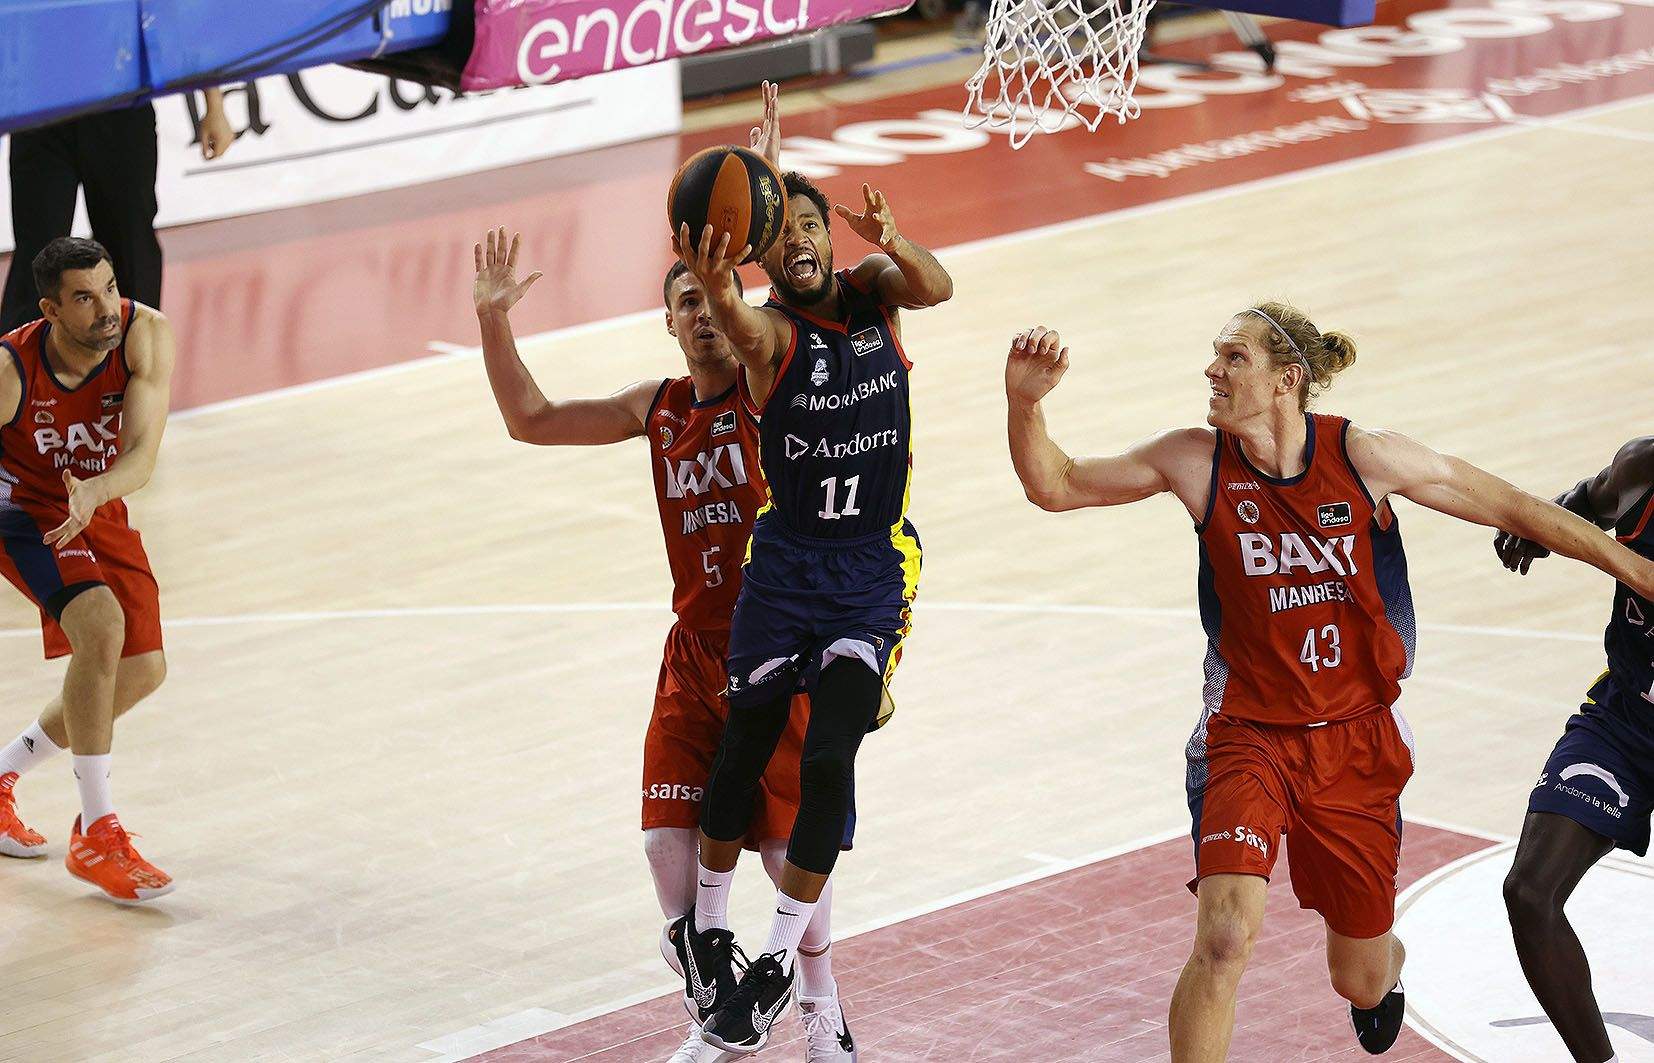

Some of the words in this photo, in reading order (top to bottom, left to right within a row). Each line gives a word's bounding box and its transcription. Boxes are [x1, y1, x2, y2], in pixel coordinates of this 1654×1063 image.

[517, 0, 809, 85] endesa
[809, 370, 898, 411] MORABANC
[813, 428, 898, 459] Andorra
[818, 474, 861, 520] 11
[701, 546, 723, 588] 5
[1237, 532, 1359, 576] BAXI
[1300, 624, 1341, 672] 43
[649, 783, 704, 802] sarsa
[1554, 782, 1591, 803] Andorra
[1592, 796, 1600, 808] la
[1603, 802, 1622, 819] Vella
